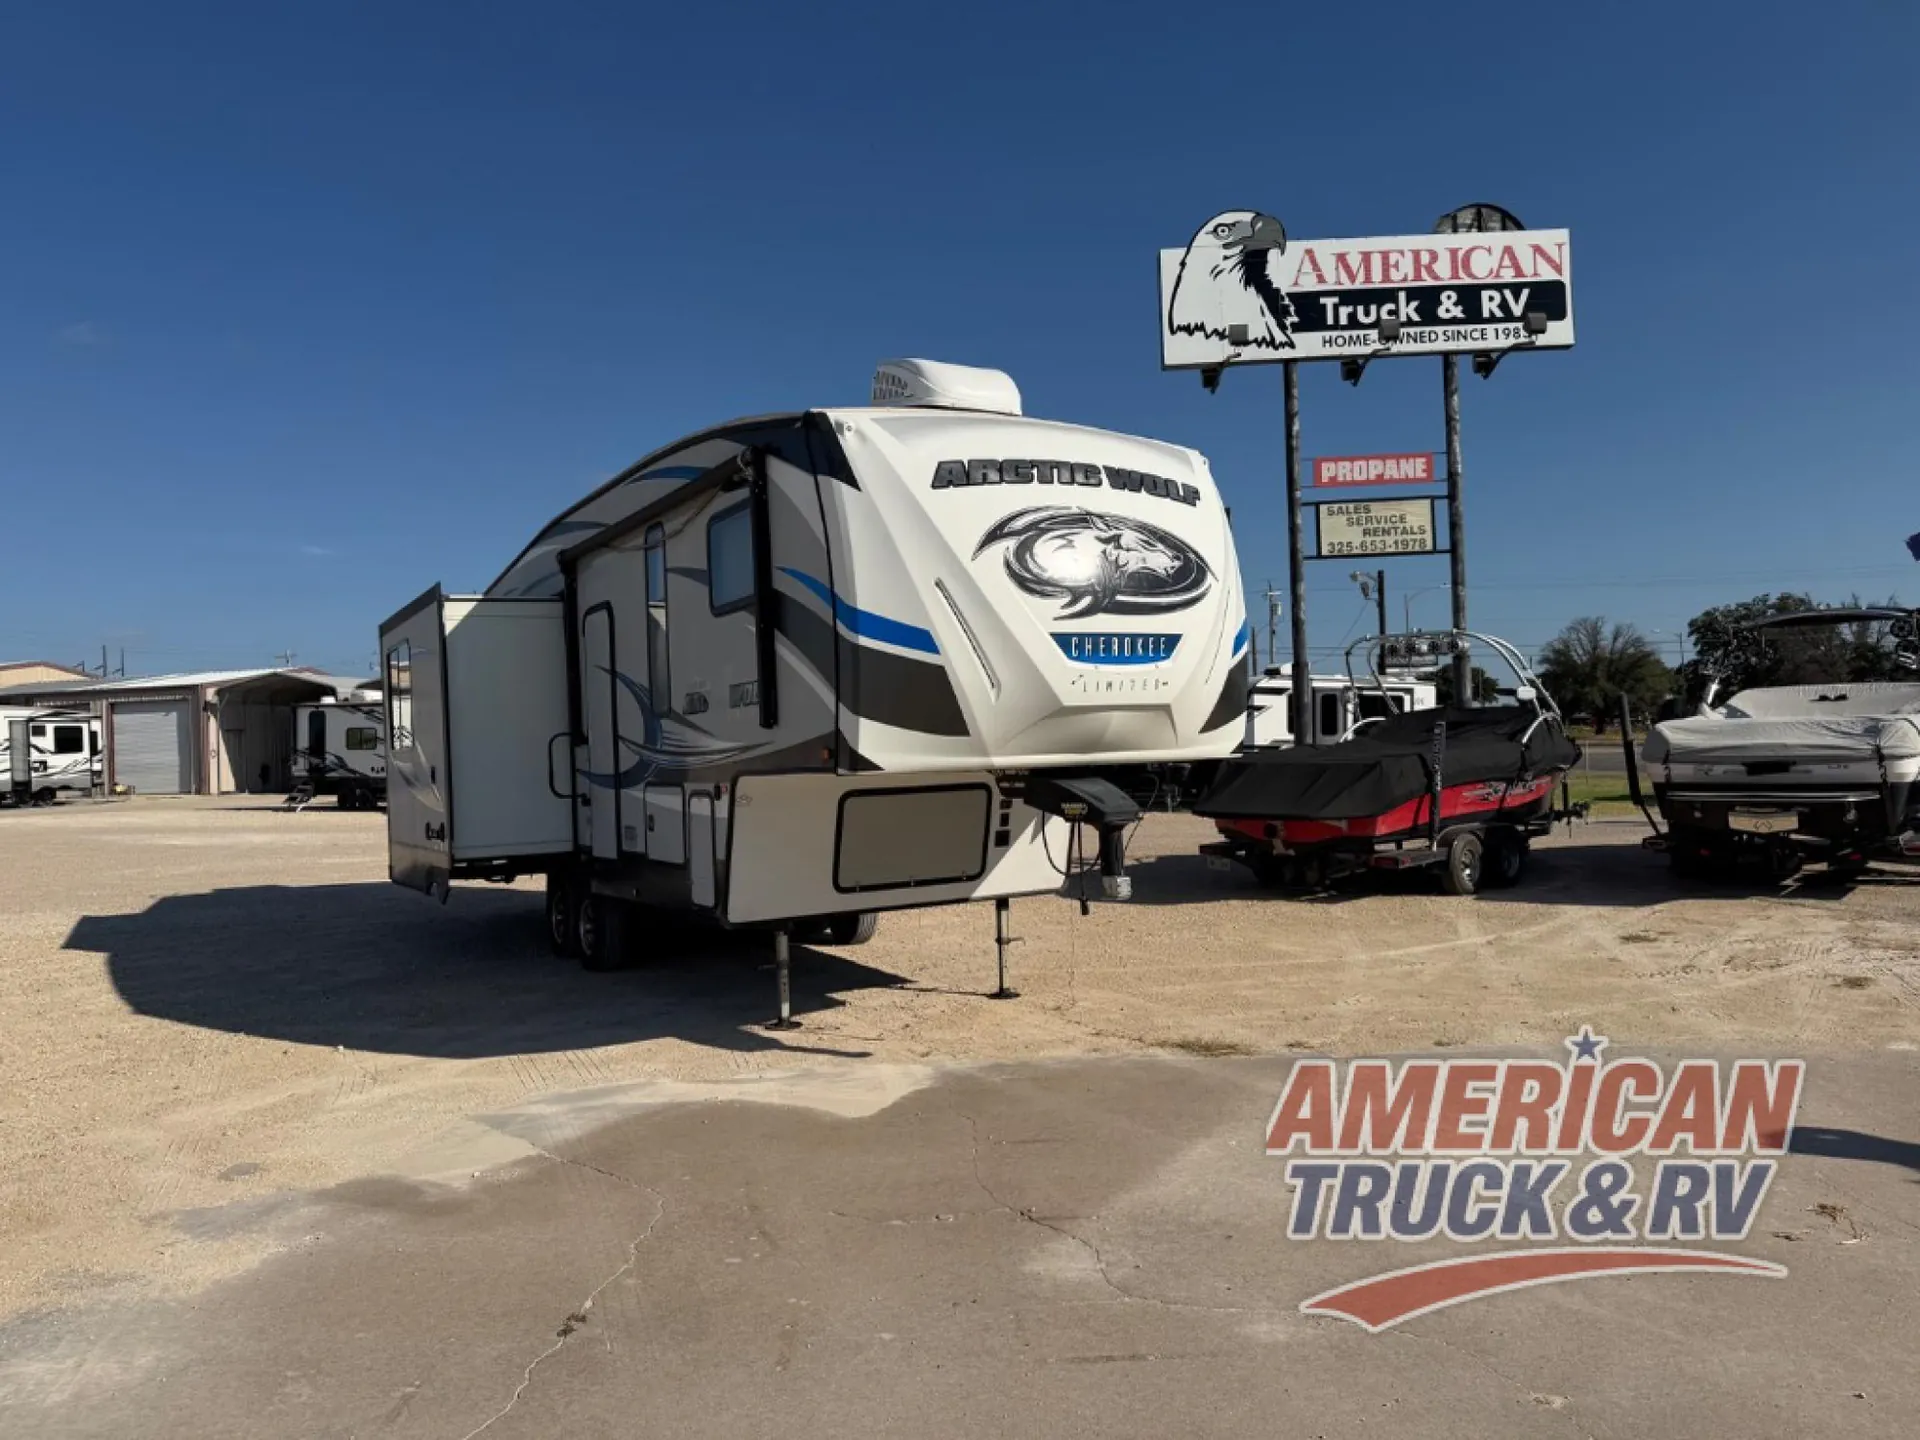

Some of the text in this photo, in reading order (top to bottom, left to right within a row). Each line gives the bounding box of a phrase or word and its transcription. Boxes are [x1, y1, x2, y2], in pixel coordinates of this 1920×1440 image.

[1291, 243, 1565, 287] AMERICAN
[1320, 288, 1531, 325] Truck & RV
[1321, 329, 1439, 348] HOME-WNED
[1443, 327, 1488, 342] SINCE
[1321, 457, 1428, 483] PROPANE
[930, 459, 1200, 507] ARCTIC WOLF
[1326, 504, 1372, 517] SALES
[1346, 514, 1408, 527] SERVICE
[1362, 525, 1427, 538] RENTALS
[1071, 636, 1167, 657] CHEROKEE
